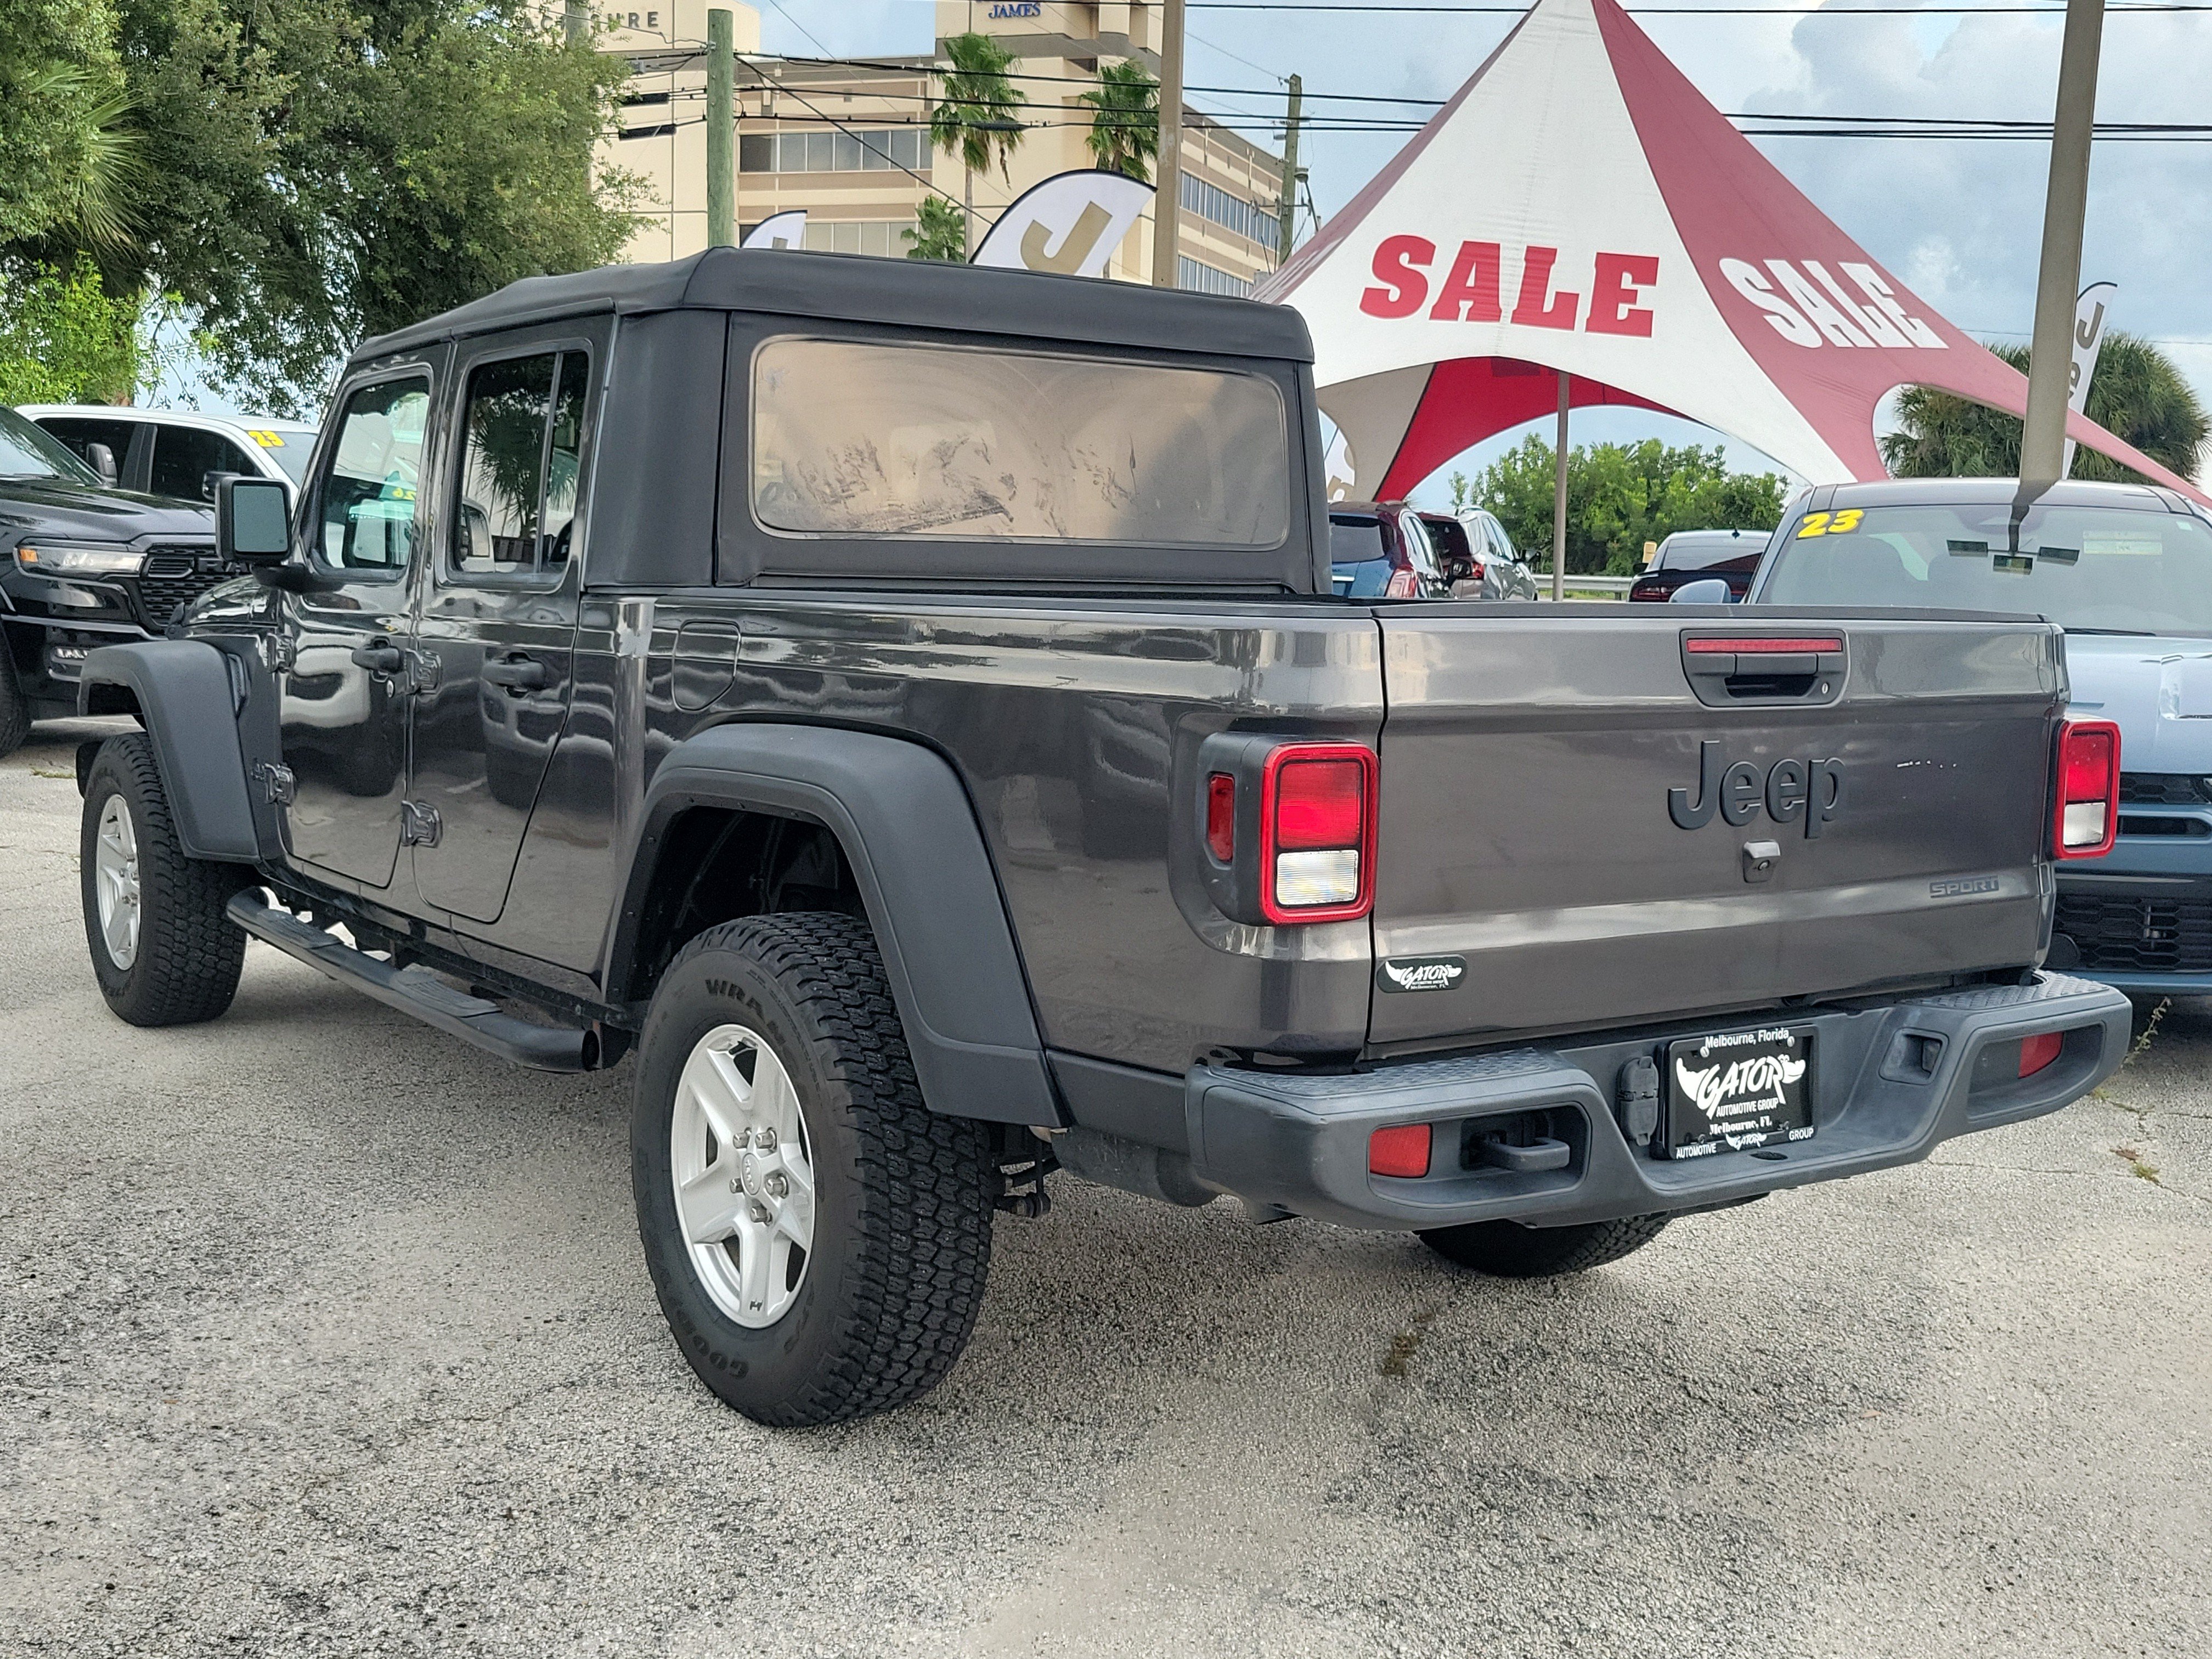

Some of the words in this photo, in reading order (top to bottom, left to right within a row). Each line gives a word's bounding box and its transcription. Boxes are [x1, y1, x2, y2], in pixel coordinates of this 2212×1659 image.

[989, 2, 1041, 19] JAMES
[1359, 234, 1659, 338] SALE
[1718, 257, 1950, 349] SALE
[248, 430, 285, 448] 23
[1797, 510, 1865, 538] 23
[199, 557, 256, 573] RA
[1667, 740, 1846, 840] Jeep
[1930, 877, 1999, 898] SPORT
[1400, 964, 1449, 990] GATOR
[1705, 1033, 1756, 1049] Melbourne,
[1758, 1028, 1790, 1042] Florida
[1696, 1055, 1786, 1120] GATOR
[1716, 1101, 1757, 1118] AUTOMOTIVE
[1757, 1098, 1779, 1110] GROUP
[1709, 1121, 1759, 1135] Melbourne,
[1676, 1143, 1717, 1159] AUTOMOTIVE
[1735, 1133, 1762, 1151] GATOR
[1788, 1128, 1814, 1141] GROUP
